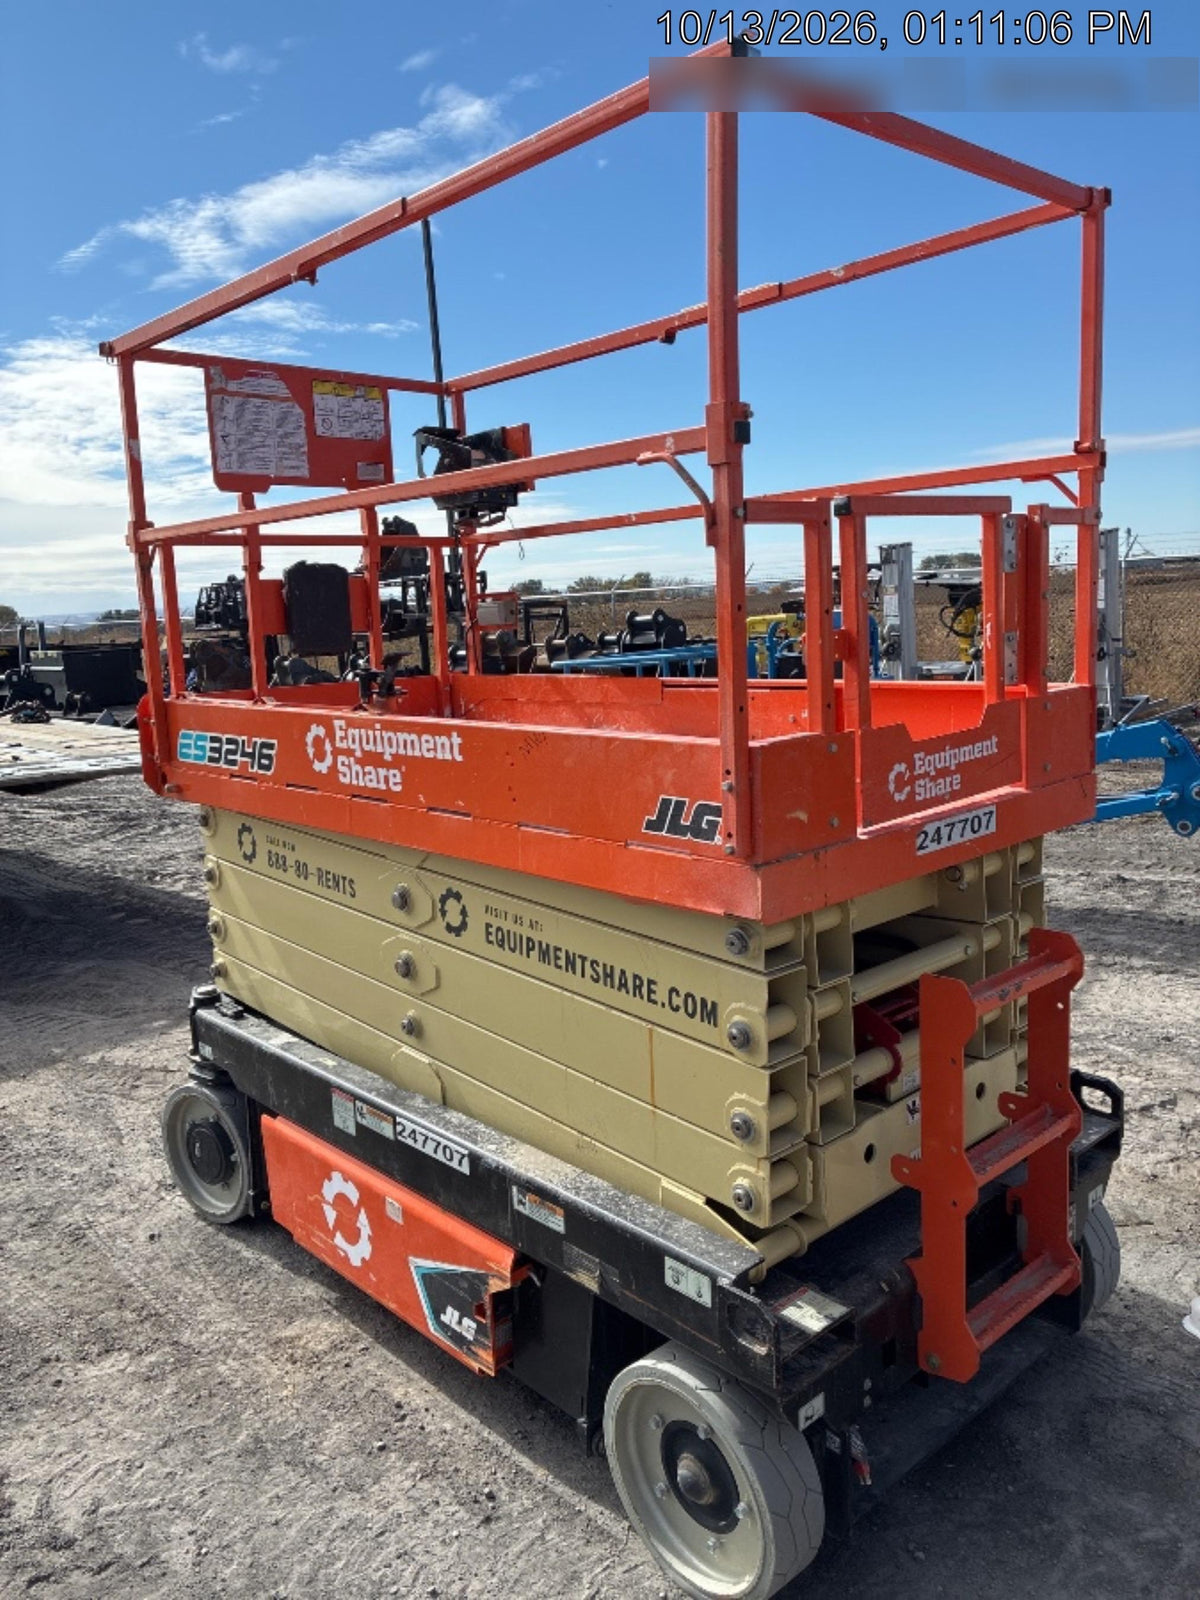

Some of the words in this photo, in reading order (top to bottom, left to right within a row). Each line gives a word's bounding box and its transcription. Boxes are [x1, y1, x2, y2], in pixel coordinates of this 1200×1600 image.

[177, 729, 277, 776] ES3246
[333, 720, 464, 762] Equipment
[913, 735, 999, 776] Equipment
[336, 755, 403, 792] Share
[914, 774, 961, 802] Share
[641, 794, 722, 845] JLG
[917, 810, 995, 852] 247707
[484, 921, 719, 1029] EQUIPMENTSHARE.COM
[397, 1121, 468, 1168] 247707
[440, 1305, 477, 1341] JLG
